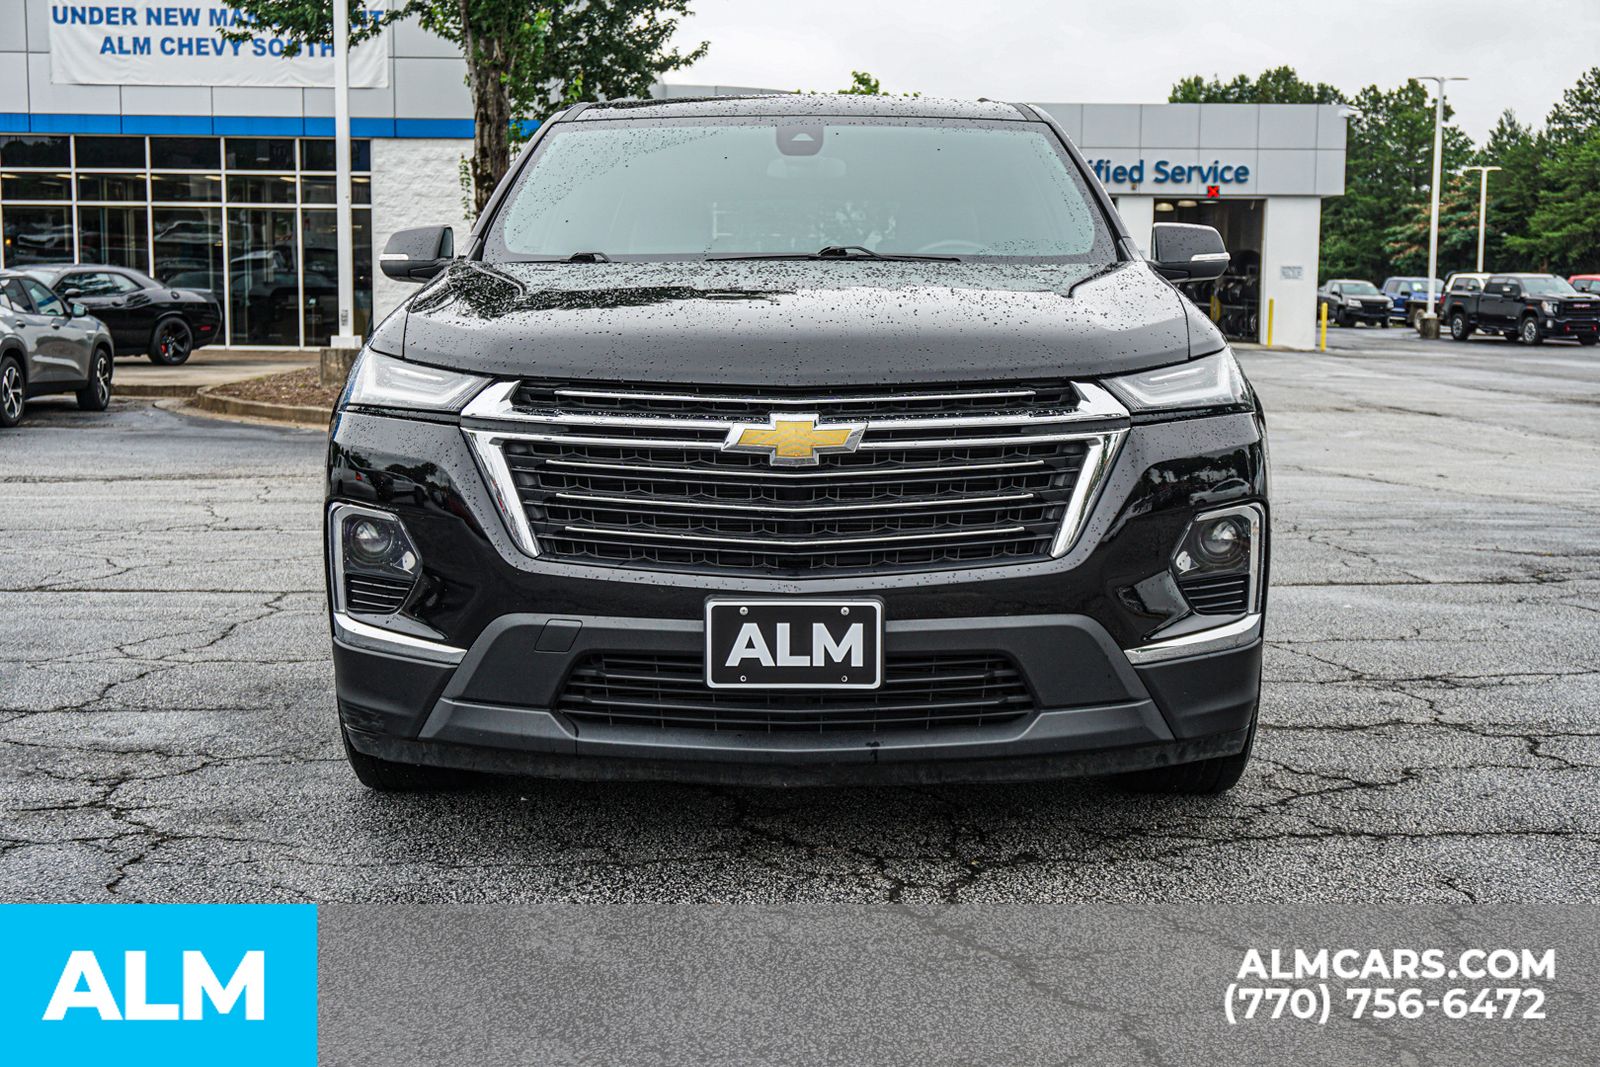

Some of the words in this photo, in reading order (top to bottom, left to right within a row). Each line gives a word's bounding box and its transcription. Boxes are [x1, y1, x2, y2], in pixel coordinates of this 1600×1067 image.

[52, 5, 138, 26] UNDER
[146, 8, 201, 27] NEW
[99, 36, 152, 55] ALM
[160, 37, 243, 57] CHEVY
[1153, 160, 1249, 184] Service
[725, 622, 864, 667] ALM
